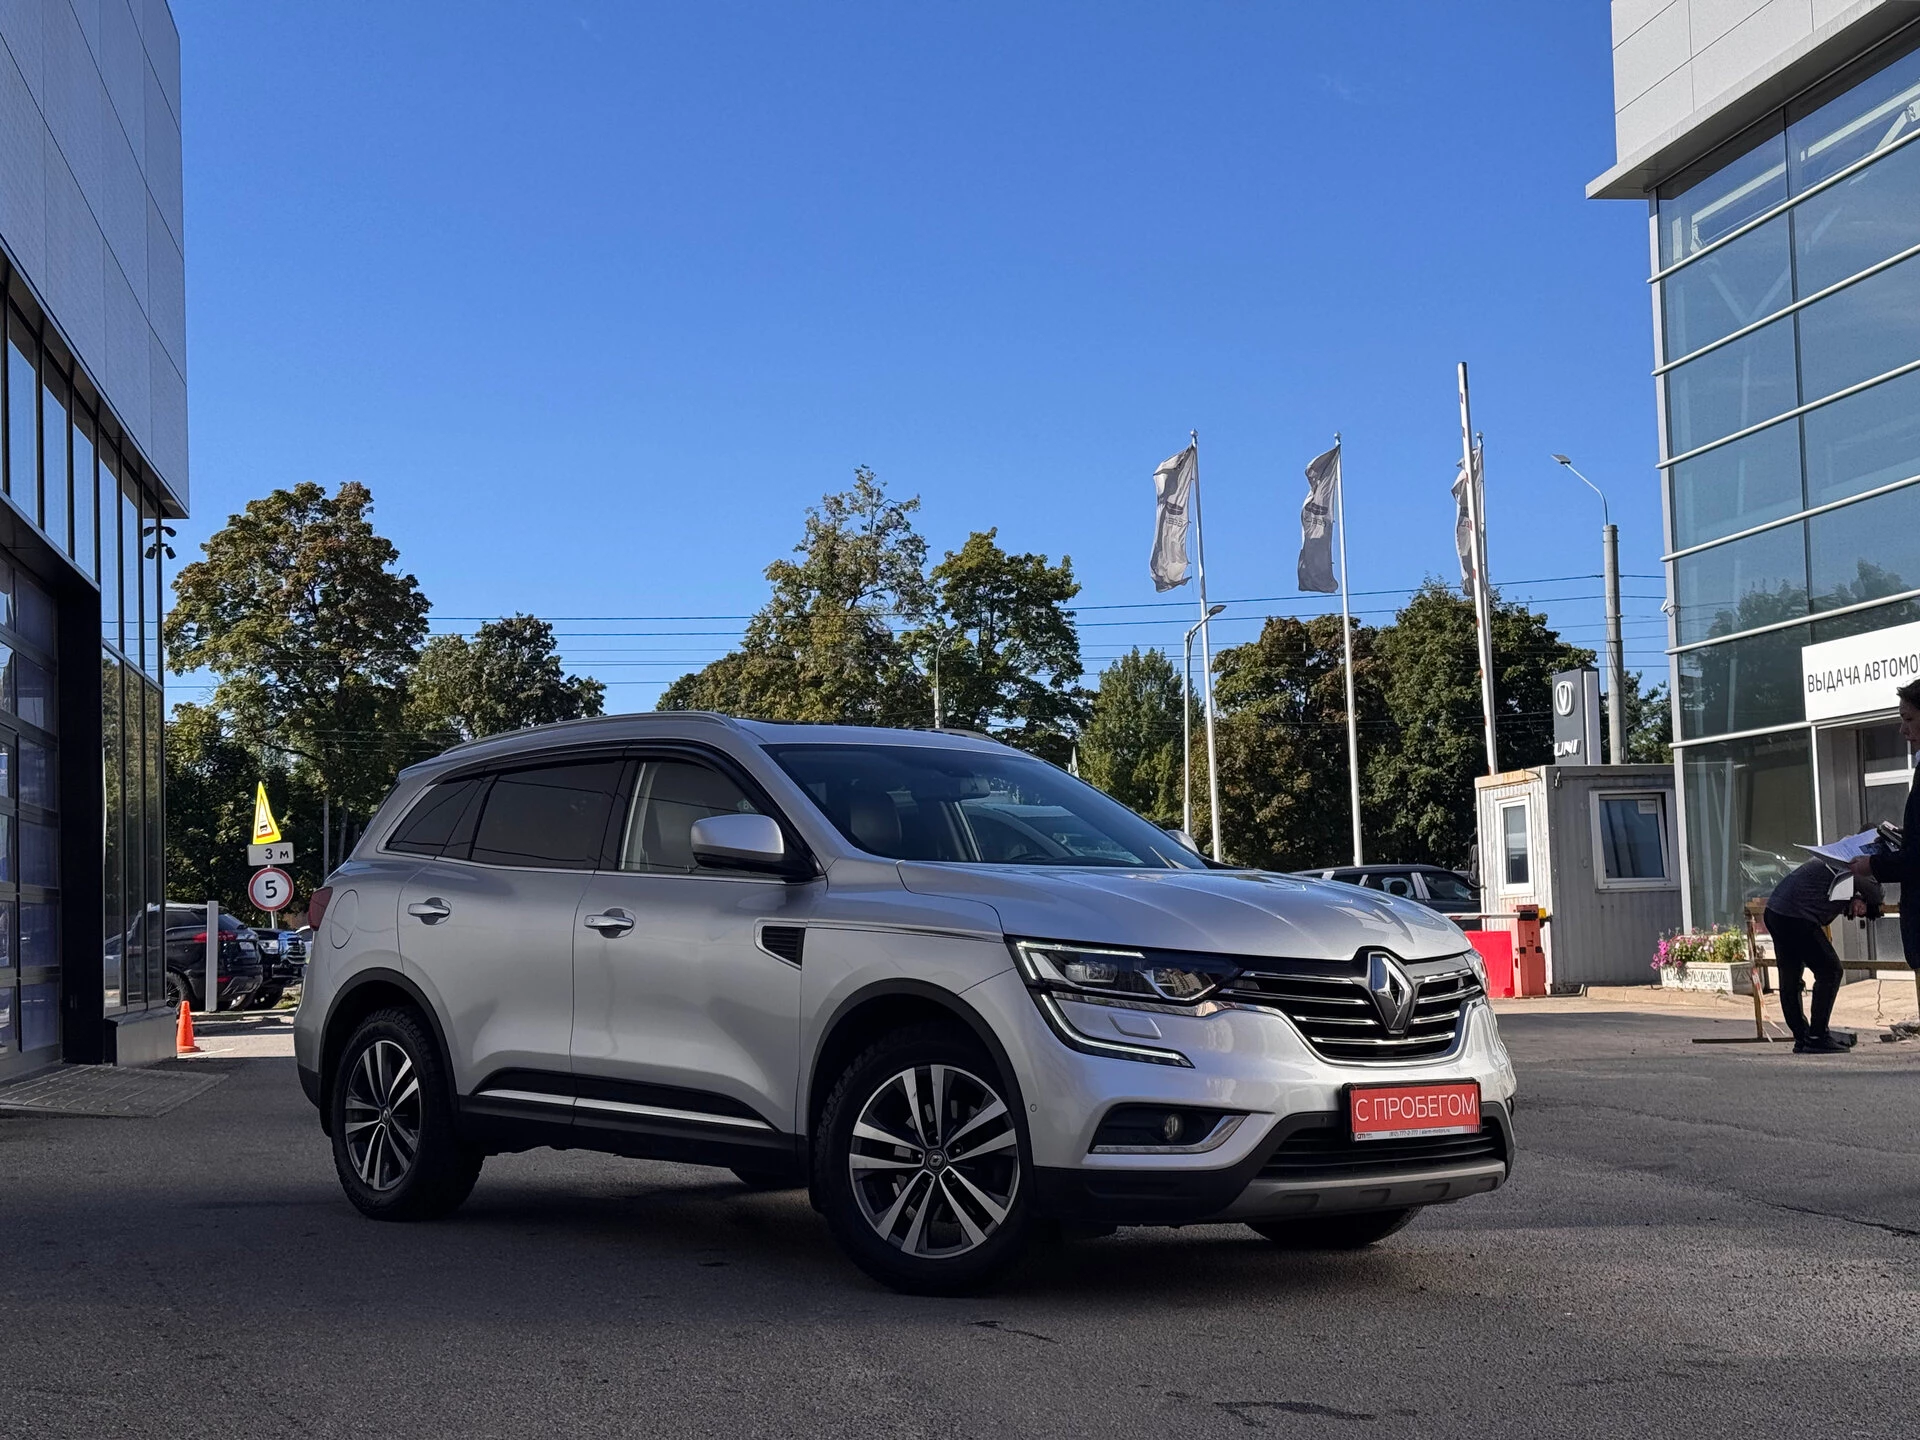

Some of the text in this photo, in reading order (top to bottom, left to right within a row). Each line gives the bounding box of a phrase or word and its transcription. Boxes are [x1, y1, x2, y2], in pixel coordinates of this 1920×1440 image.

[1808, 652, 1920, 693] ВЫДАЧА АВТОМО
[1554, 739, 1579, 756] UNI
[265, 848, 273, 860] 3
[265, 880, 277, 899] 5
[1355, 1092, 1476, 1122] С ПРОБЕГОМ
